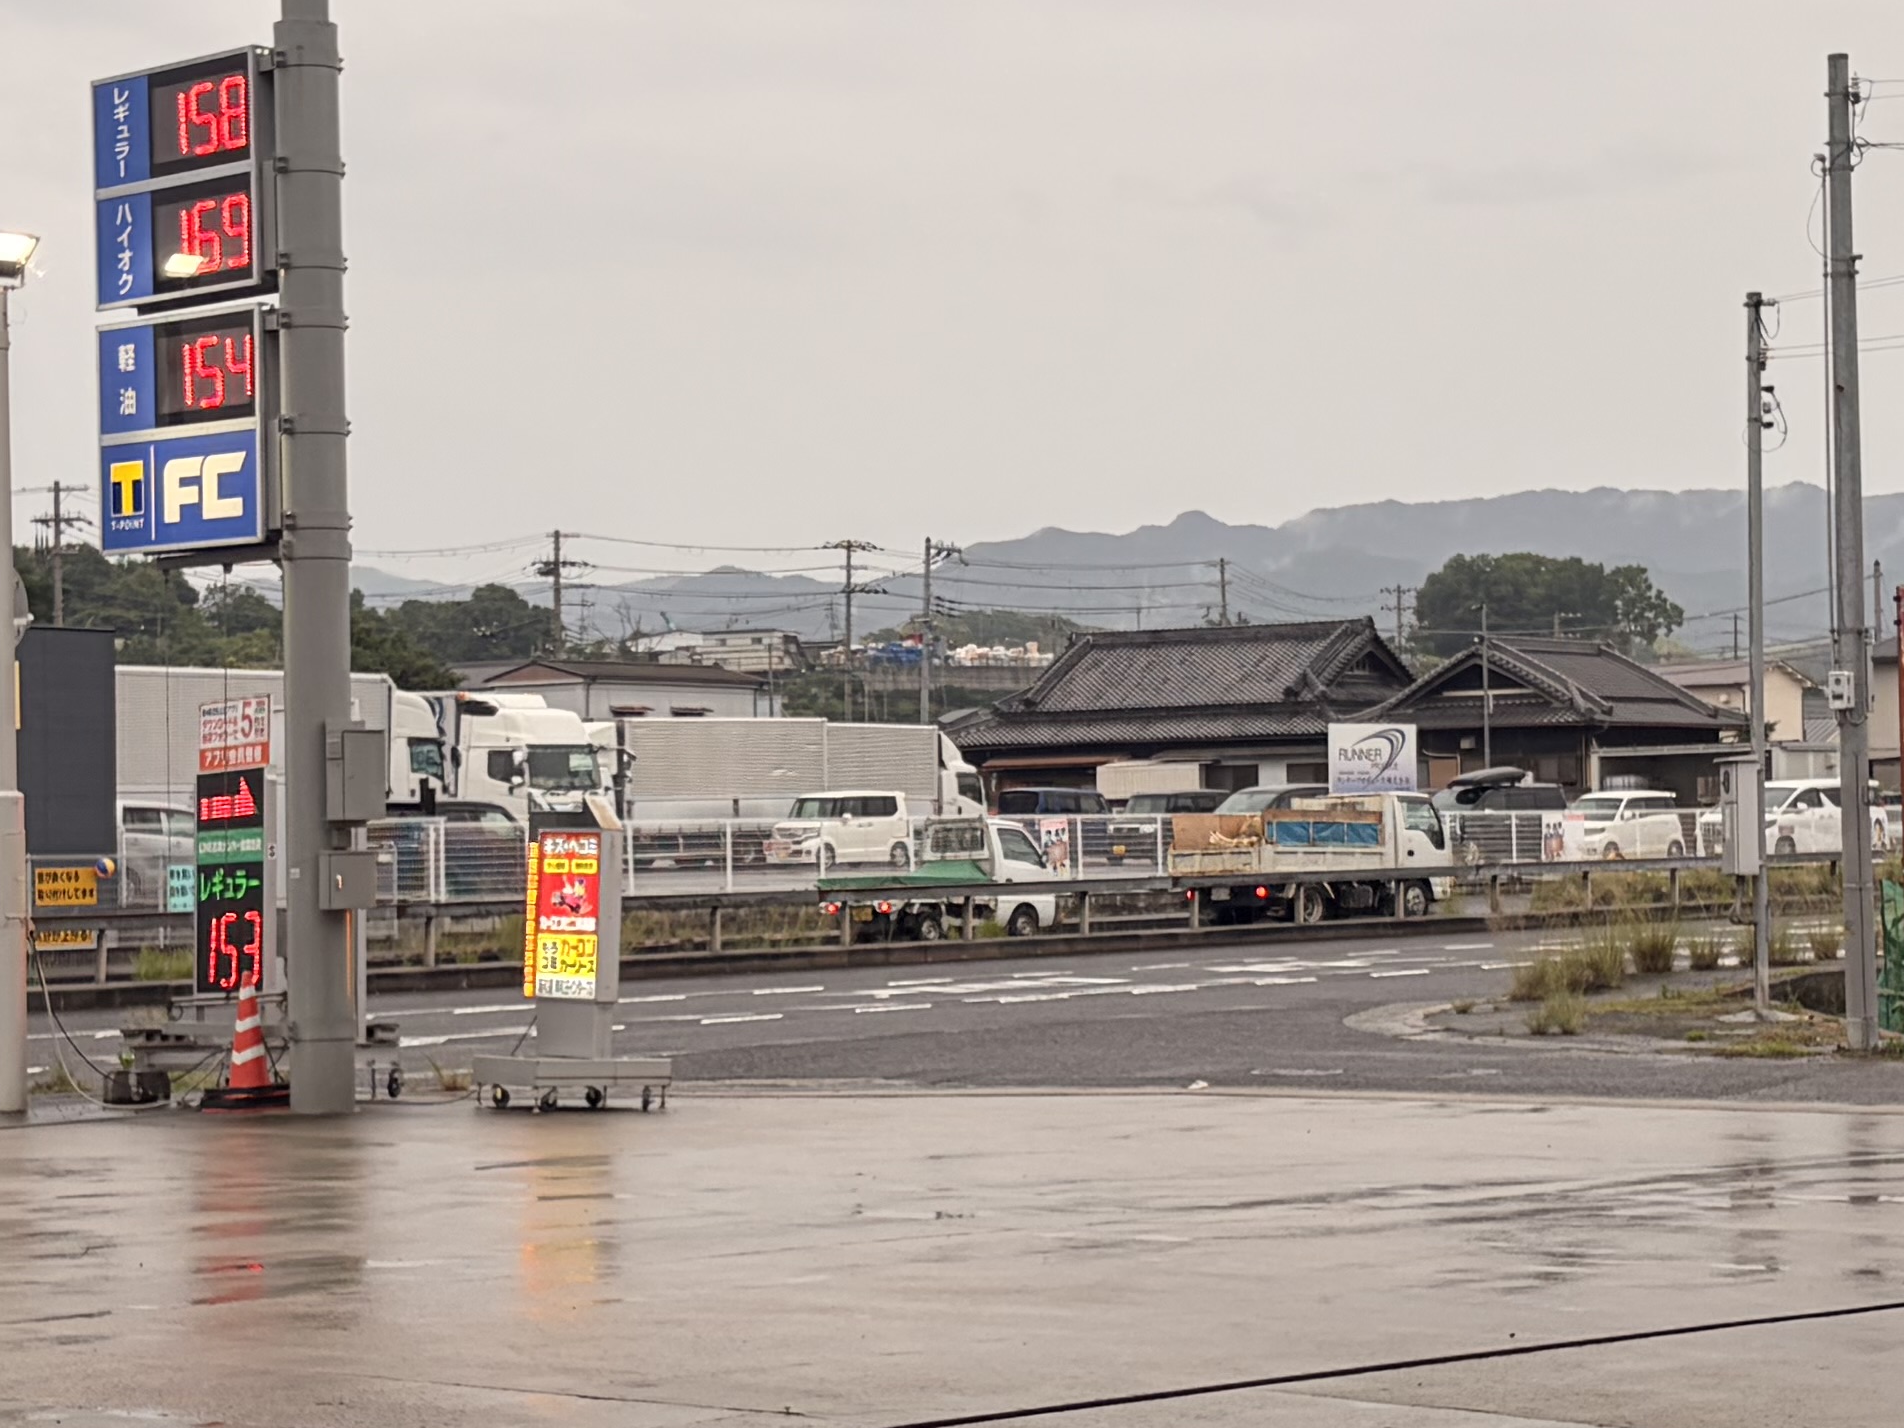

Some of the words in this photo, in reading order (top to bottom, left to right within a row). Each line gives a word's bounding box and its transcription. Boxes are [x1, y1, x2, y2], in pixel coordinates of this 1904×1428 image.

[112, 87, 130, 178] レギュラー
[177, 75, 247, 156] 158
[115, 202, 133, 296] ハイオク
[179, 194, 250, 275] 169
[117, 343, 137, 416] 軽油
[182, 334, 254, 409] 154
[110, 460, 144, 517] T
[163, 450, 247, 524] FC
[110, 518, 145, 531] T-POINT
[240, 700, 253, 739] 5
[1338, 747, 1383, 762] RUNNER
[200, 868, 261, 902] レギュラー
[208, 910, 262, 989] 153
